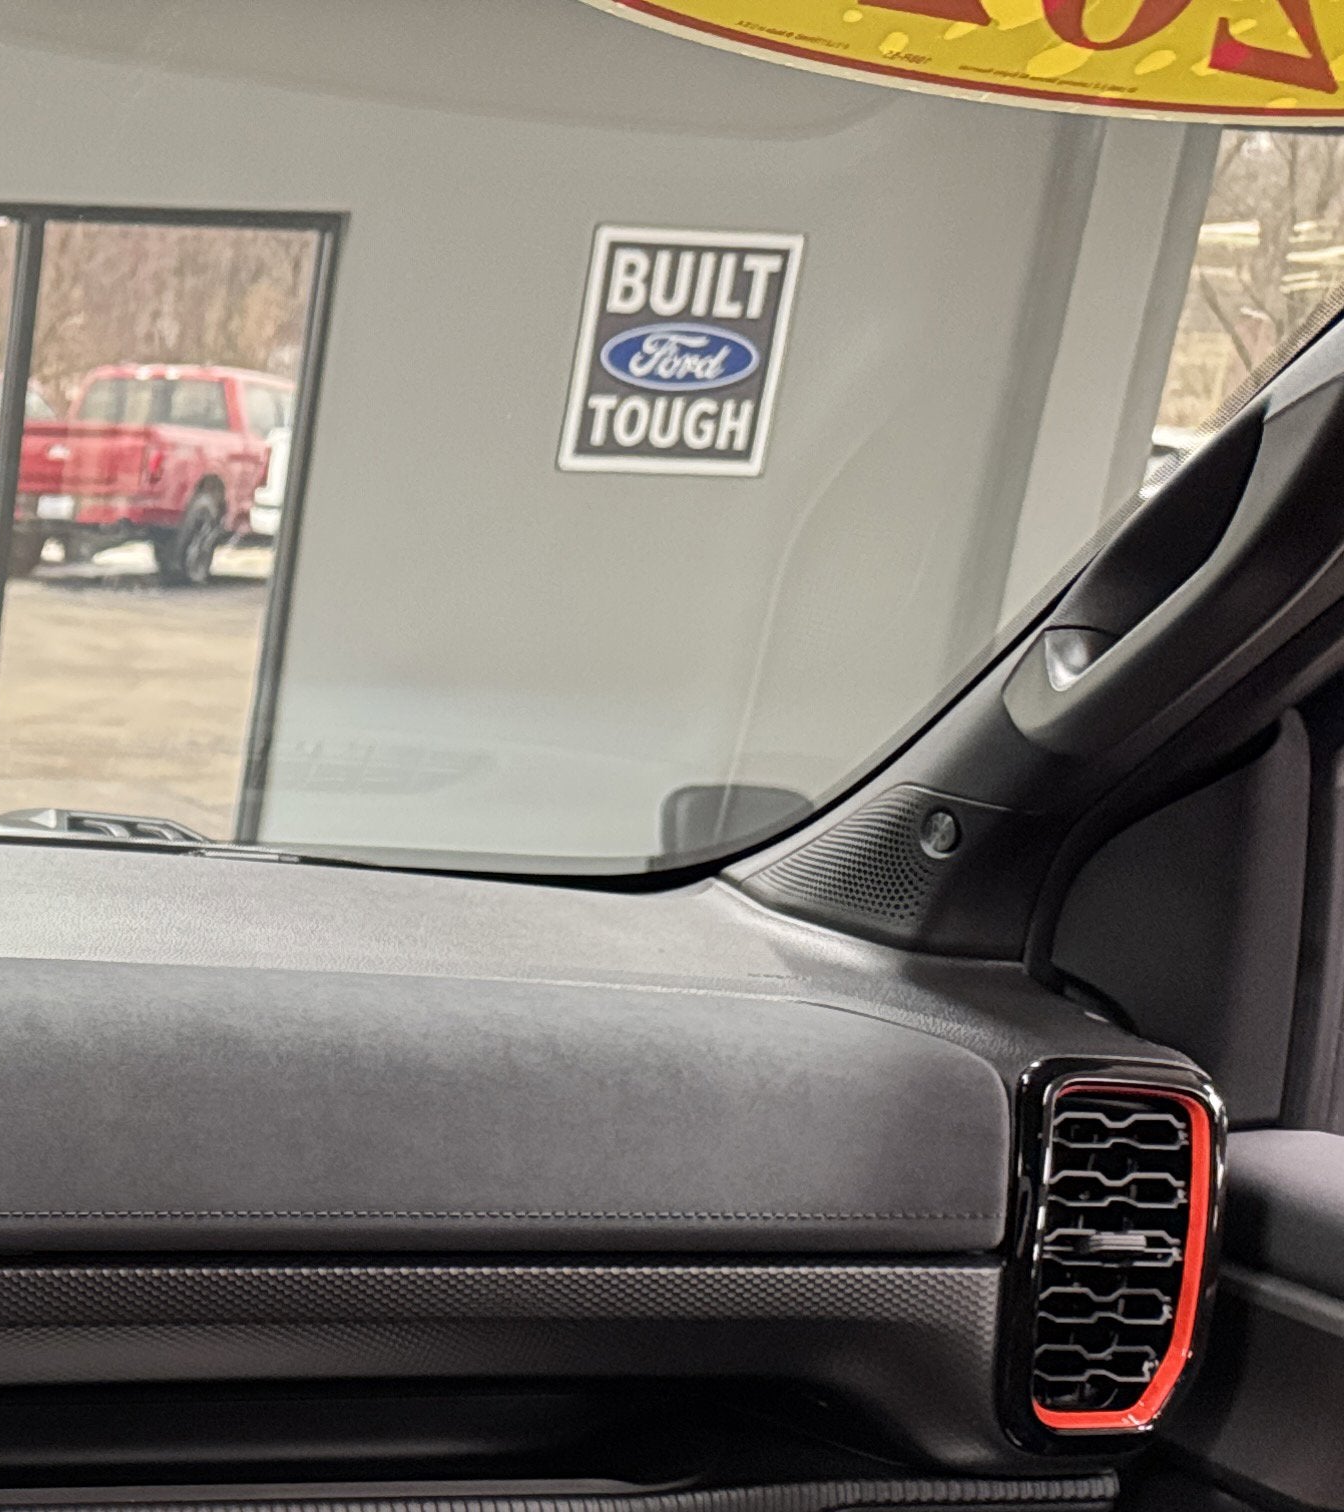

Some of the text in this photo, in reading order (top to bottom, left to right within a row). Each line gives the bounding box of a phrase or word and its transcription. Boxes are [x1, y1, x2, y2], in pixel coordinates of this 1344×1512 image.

[606, 247, 783, 320] BUILT
[628, 331, 732, 380] Ford
[587, 394, 755, 451] TOUGH
